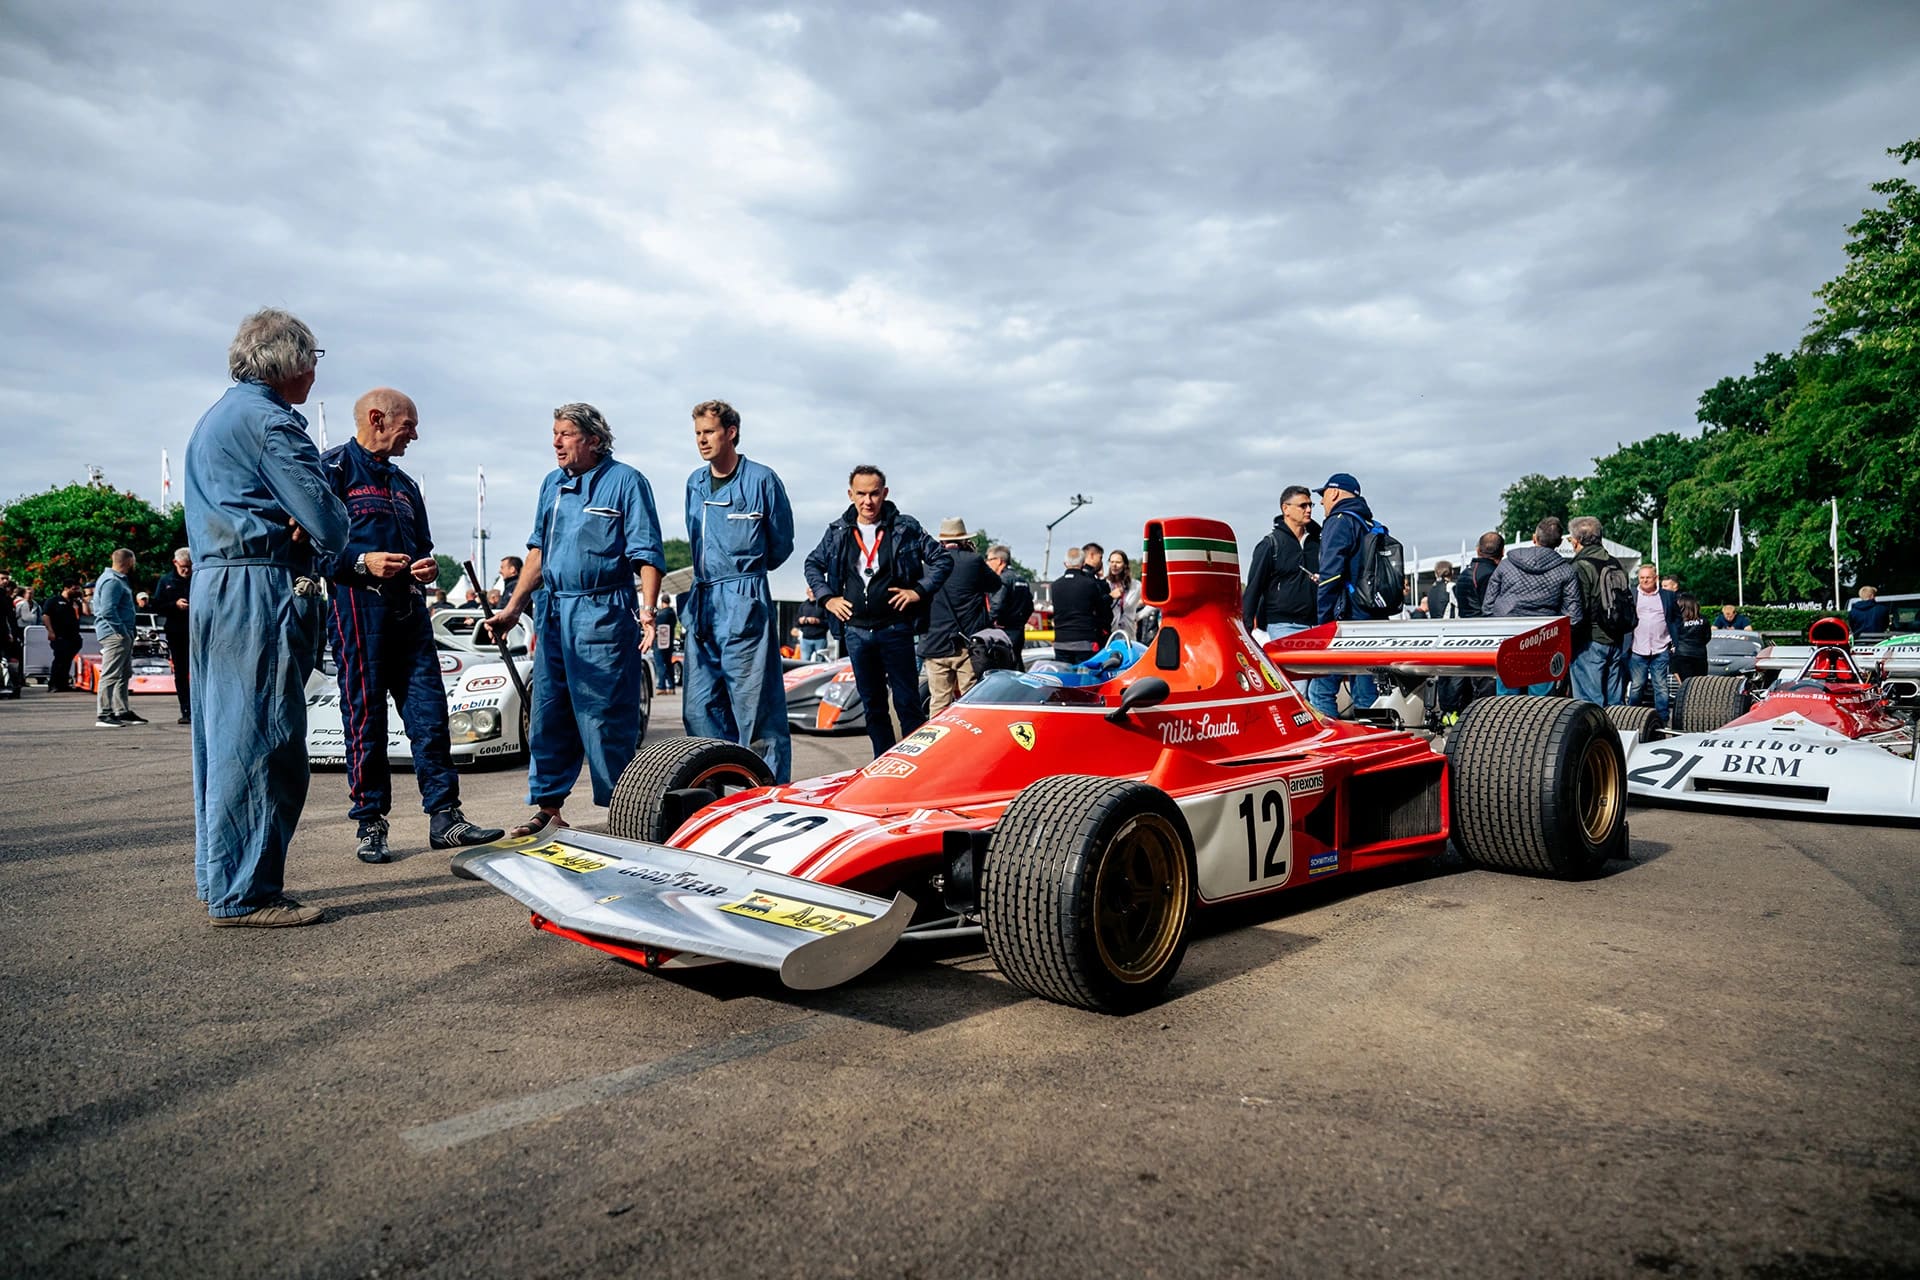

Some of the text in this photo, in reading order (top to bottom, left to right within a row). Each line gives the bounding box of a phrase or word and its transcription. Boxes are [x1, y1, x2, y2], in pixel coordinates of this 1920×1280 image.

[1332, 638, 1505, 648] GOODYEAR GOOD
[1519, 626, 1560, 650] GOODYEAR
[451, 699, 486, 713] Mobil
[1158, 718, 1195, 745] Niki
[1196, 713, 1240, 741] Lauda
[479, 742, 520, 755] GOODYEAR
[1698, 739, 1838, 756] Marlboro
[1627, 747, 1704, 790] 21
[1720, 754, 1803, 777] BRM
[1290, 774, 1324, 793] arexons
[718, 811, 829, 865] 12
[1239, 789, 1287, 882] 12
[618, 867, 728, 897] GOODYEAR
